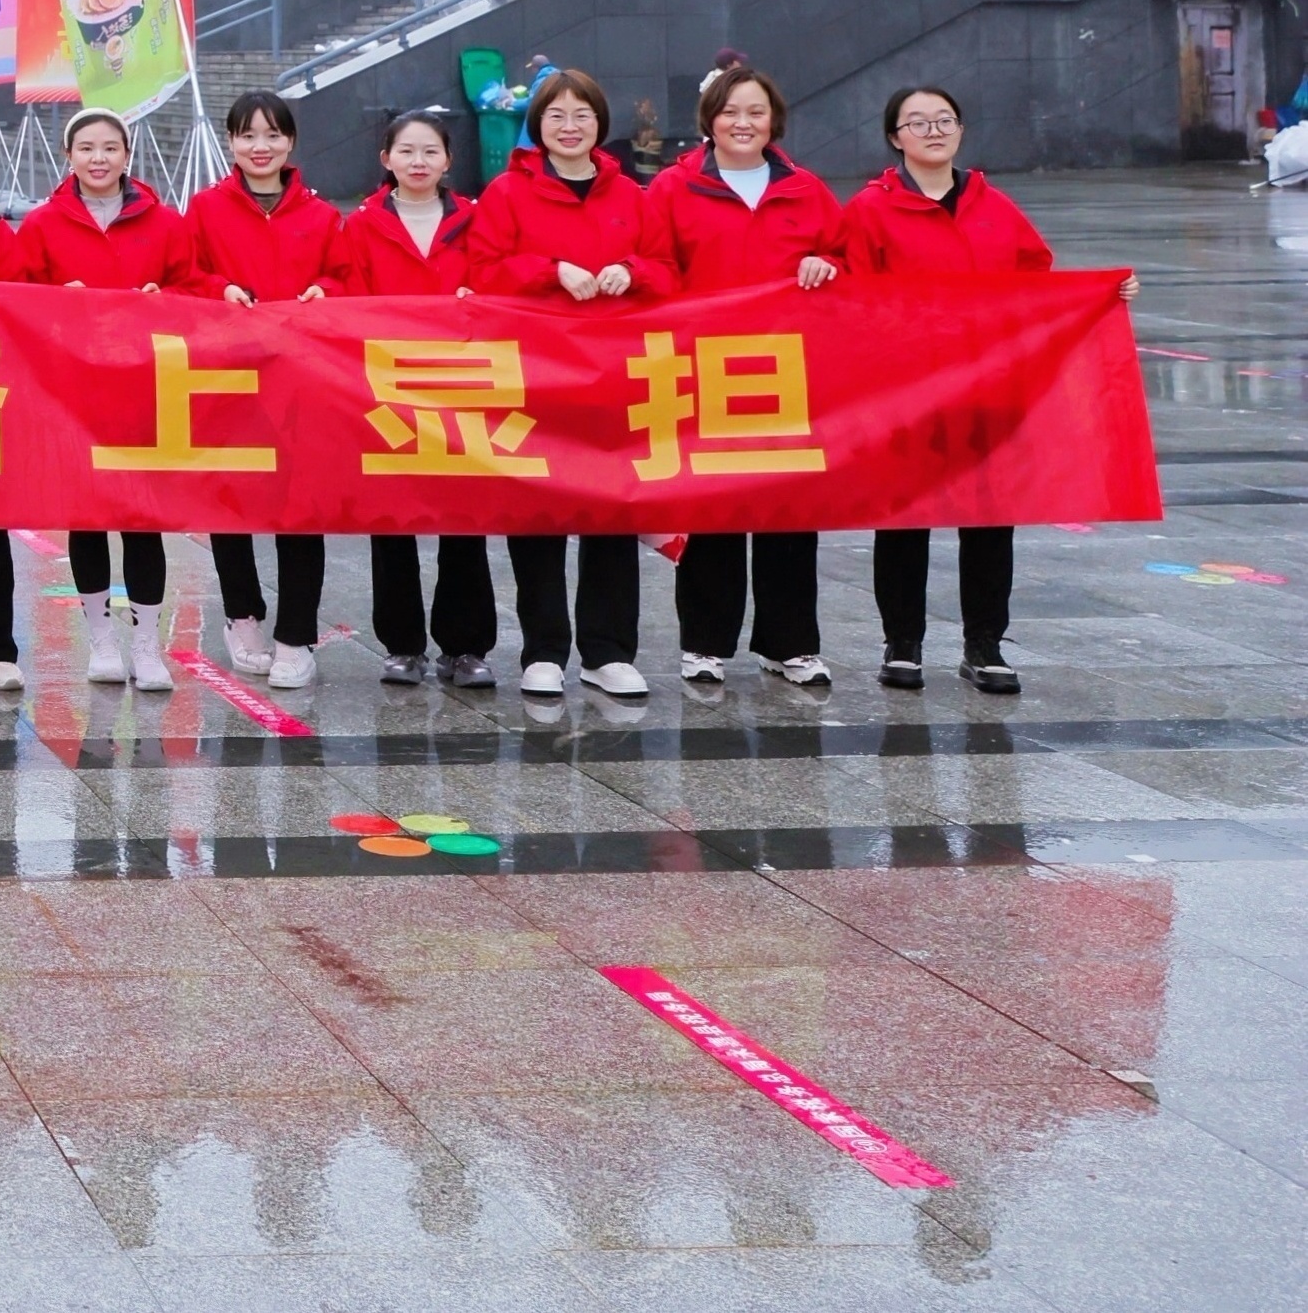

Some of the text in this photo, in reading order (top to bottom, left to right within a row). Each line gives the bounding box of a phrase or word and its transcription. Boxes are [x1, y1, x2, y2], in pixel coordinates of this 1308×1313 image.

[646, 991, 872, 1138] 国家税务总局永嘉县税务局
